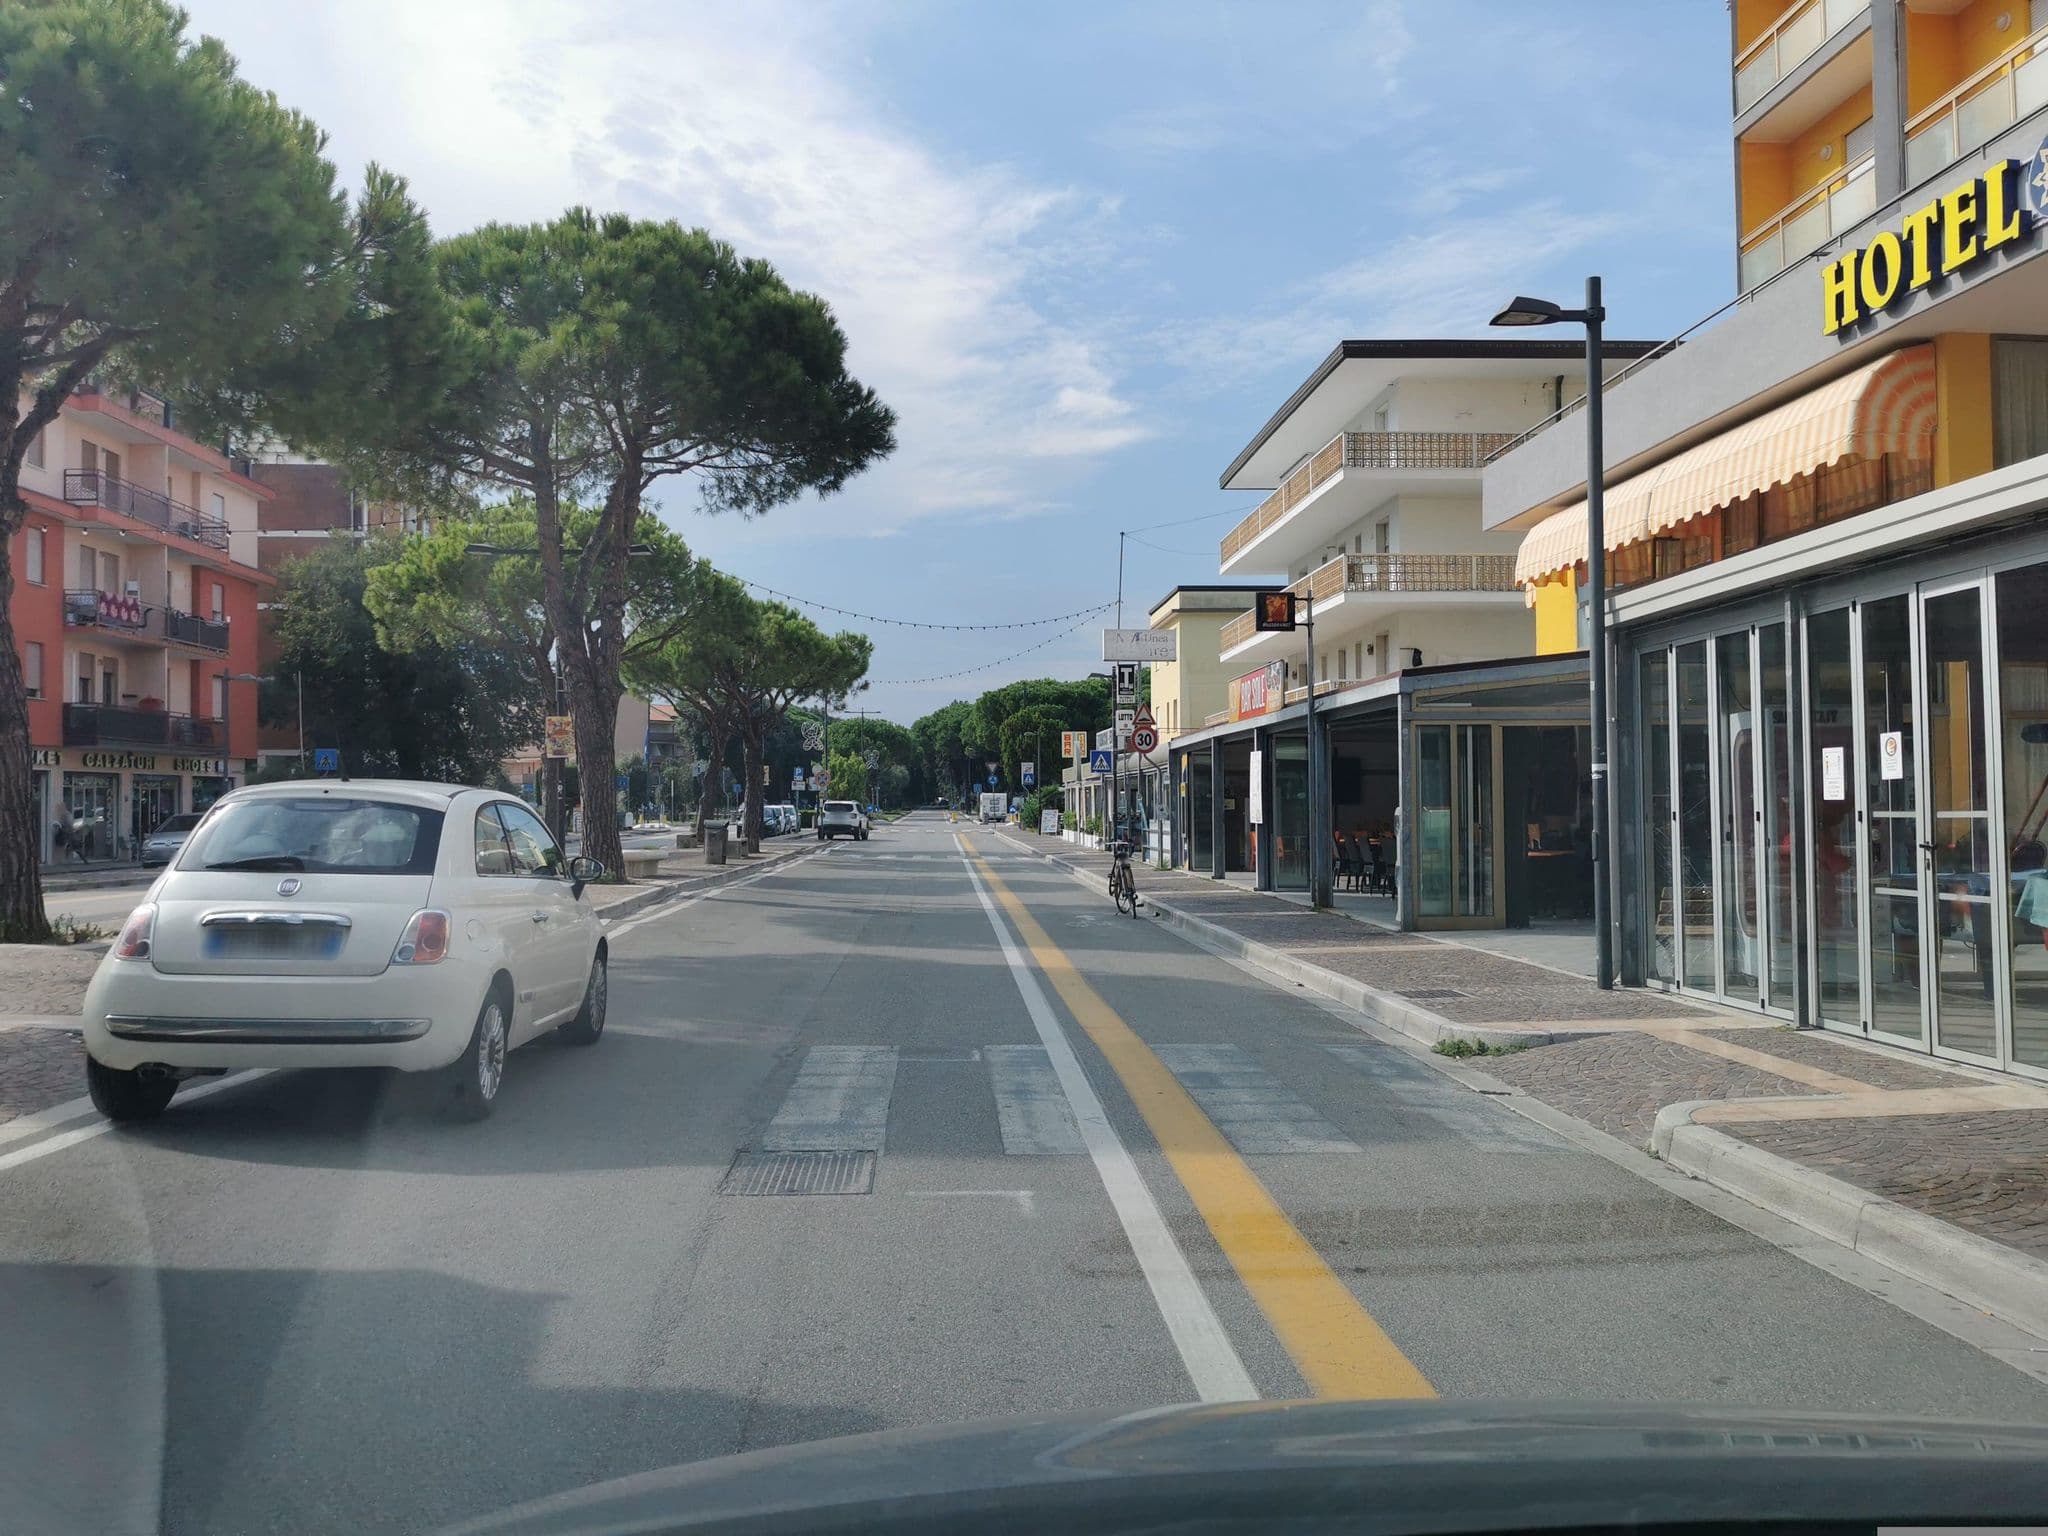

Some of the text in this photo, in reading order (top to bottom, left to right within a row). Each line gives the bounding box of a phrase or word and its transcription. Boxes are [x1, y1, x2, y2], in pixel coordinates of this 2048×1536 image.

[1821, 159, 2021, 336] HOTEL
[1241, 680, 1251, 713] BAR
[1251, 674, 1265, 710] SOLE
[1064, 734, 1072, 756] BAR
[1137, 733, 1152, 746] 30
[175, 757, 214, 773] SHOES
